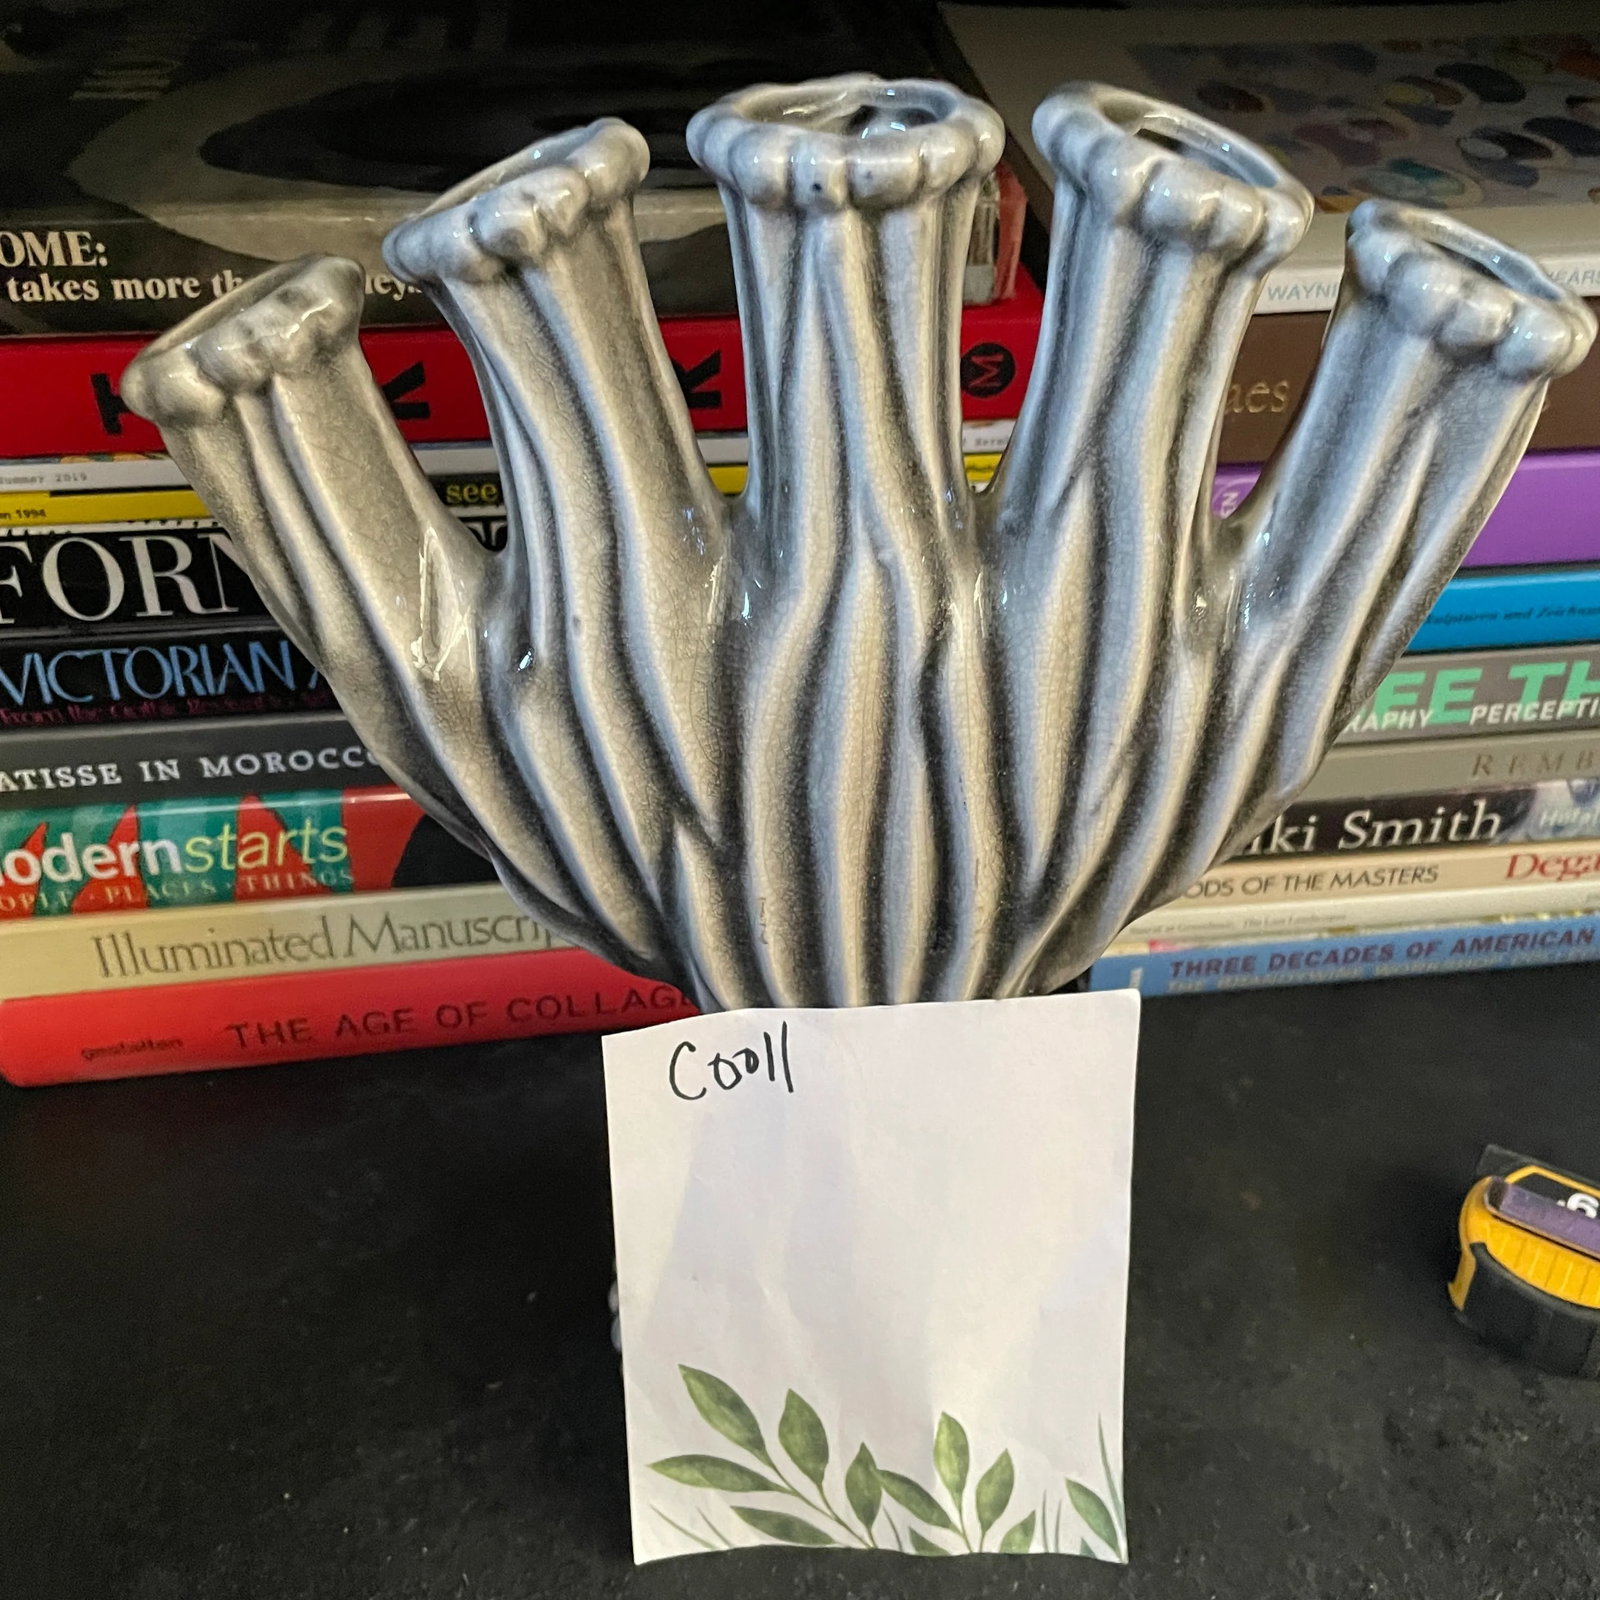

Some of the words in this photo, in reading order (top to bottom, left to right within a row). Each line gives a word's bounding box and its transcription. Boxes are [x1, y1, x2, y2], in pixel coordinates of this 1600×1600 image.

[6, 273, 100, 302] takes
[110, 276, 201, 300] more
[1267, 283, 1339, 301] WAYN
[0, 639, 297, 706] VICTORIAN
[139, 758, 182, 783] IN
[1338, 799, 1503, 850] Smith
[0, 817, 349, 888] odernstarts
[1241, 876, 1277, 896] OF
[1282, 872, 1324, 893] THE
[1330, 864, 1439, 889] MASTERS
[91, 914, 335, 978] Illuminated
[1169, 955, 1257, 979] THREE
[1267, 943, 1394, 972] DECADES
[1405, 938, 1442, 961] OF
[1450, 926, 1596, 956] AMERICAN
[225, 1017, 314, 1049] THE
[335, 1007, 415, 1038] AGE
[435, 1000, 489, 1030] OF
[506, 984, 690, 1022] COLLAG
